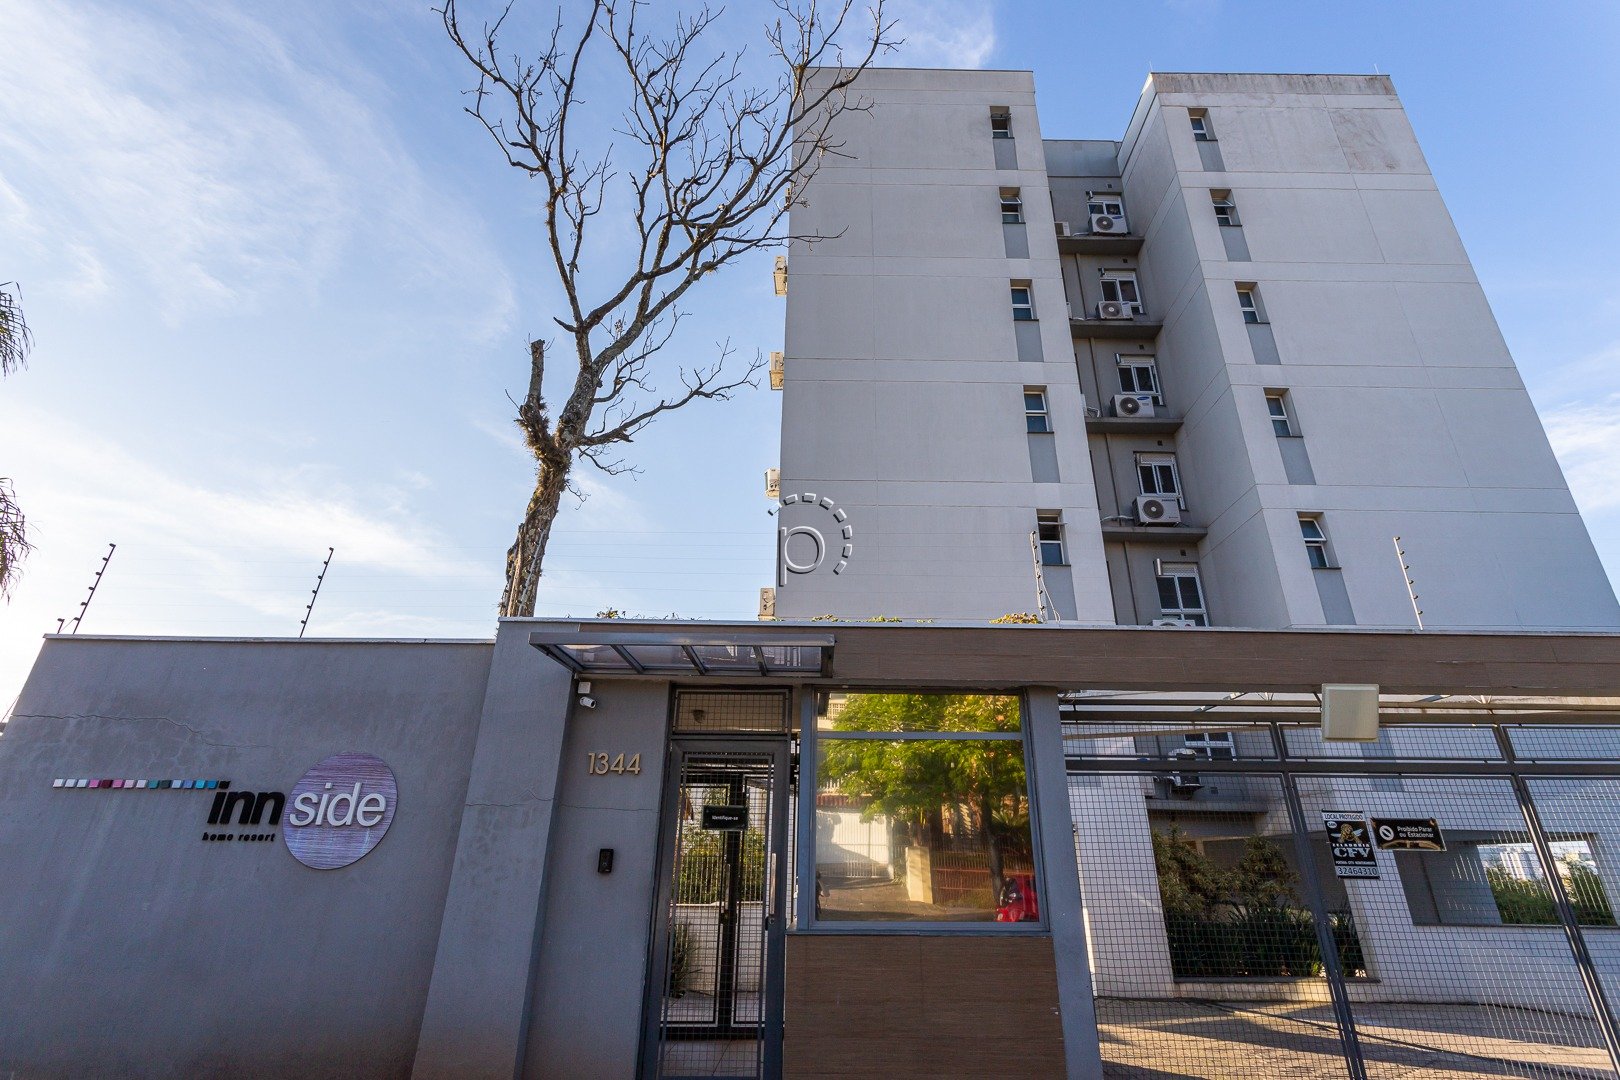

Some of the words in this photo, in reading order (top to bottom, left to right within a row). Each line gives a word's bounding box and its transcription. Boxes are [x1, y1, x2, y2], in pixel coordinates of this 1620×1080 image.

[588, 752, 642, 775] 1344
[207, 780, 286, 825] inn
[290, 782, 387, 827] side
[202, 831, 234, 842] home
[238, 832, 276, 842] resort
[1333, 847, 1371, 858] CFV
[1337, 867, 1378, 875] 32464310
